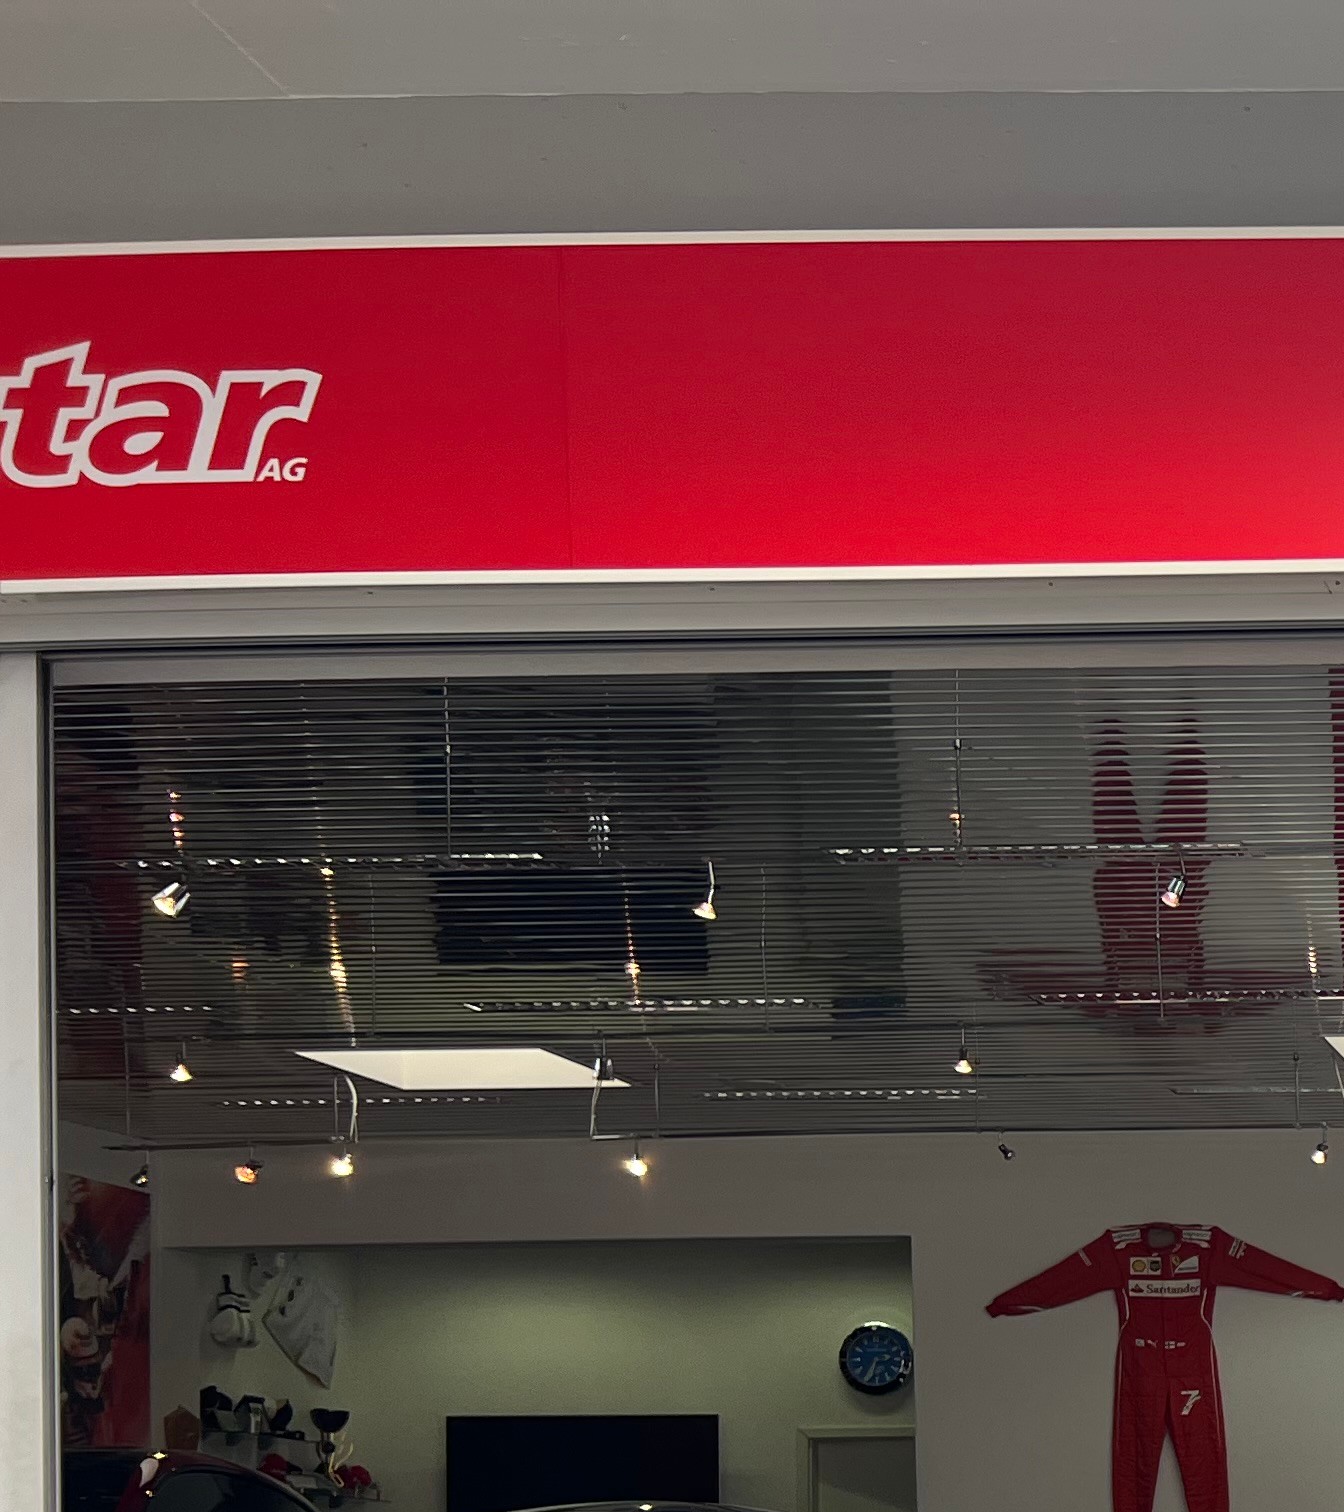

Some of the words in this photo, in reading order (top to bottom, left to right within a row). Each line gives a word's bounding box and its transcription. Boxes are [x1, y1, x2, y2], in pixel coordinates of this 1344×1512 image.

[256, 457, 308, 482] AG
[1146, 1283, 1200, 1294] Santander
[1179, 1389, 1202, 1416] 7
